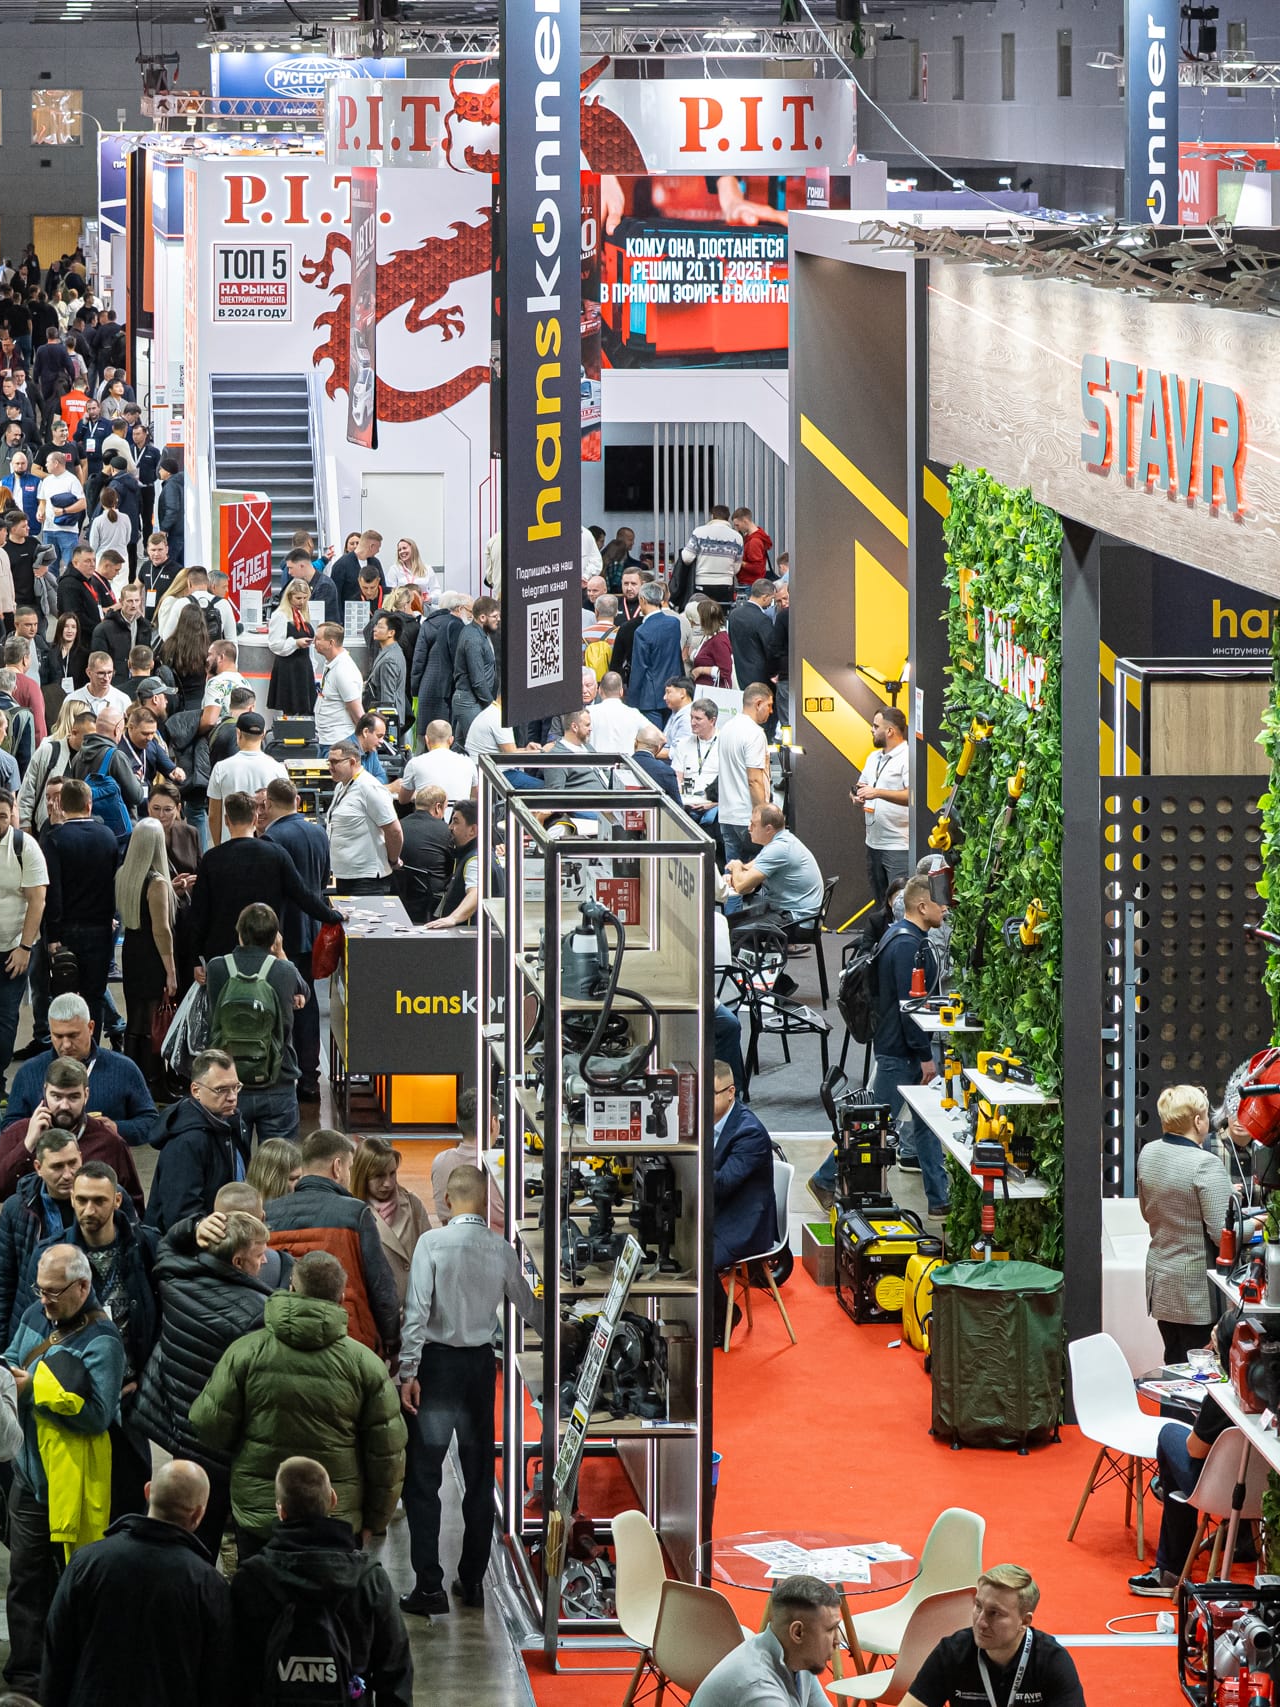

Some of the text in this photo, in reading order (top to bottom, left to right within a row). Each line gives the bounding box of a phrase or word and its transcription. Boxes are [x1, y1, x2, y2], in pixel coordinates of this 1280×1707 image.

[337, 95, 453, 152] P.I.T.
[679, 95, 823, 152] P.I.T.
[626, 238, 784, 260] КОМУ ОНА ДОСТАНЕТСЯ
[220, 249, 287, 279] ТОП 5
[633, 261, 683, 281] РЕШИМ
[686, 260, 763, 281] 20.11.2025
[220, 284, 286, 295] НА РЫНКЕ
[600, 283, 609, 304] В
[612, 283, 671, 304] ПРЯМОМ
[673, 283, 719, 304] ЭФИРЕ
[722, 283, 731, 304] В
[219, 308, 287, 319] В 2024 ГОДУ
[1081, 353, 1247, 516] STAVR
[230, 550, 269, 593] 15 ЛЕТ
[249, 568, 268, 584] РОССИИ
[516, 565, 551, 580] Подпишись
[521, 580, 568, 599] telegram канал
[1212, 599, 1279, 639] ha
[277, 1655, 338, 1683] VANS
[1015, 1691, 1042, 1700] STAVR
